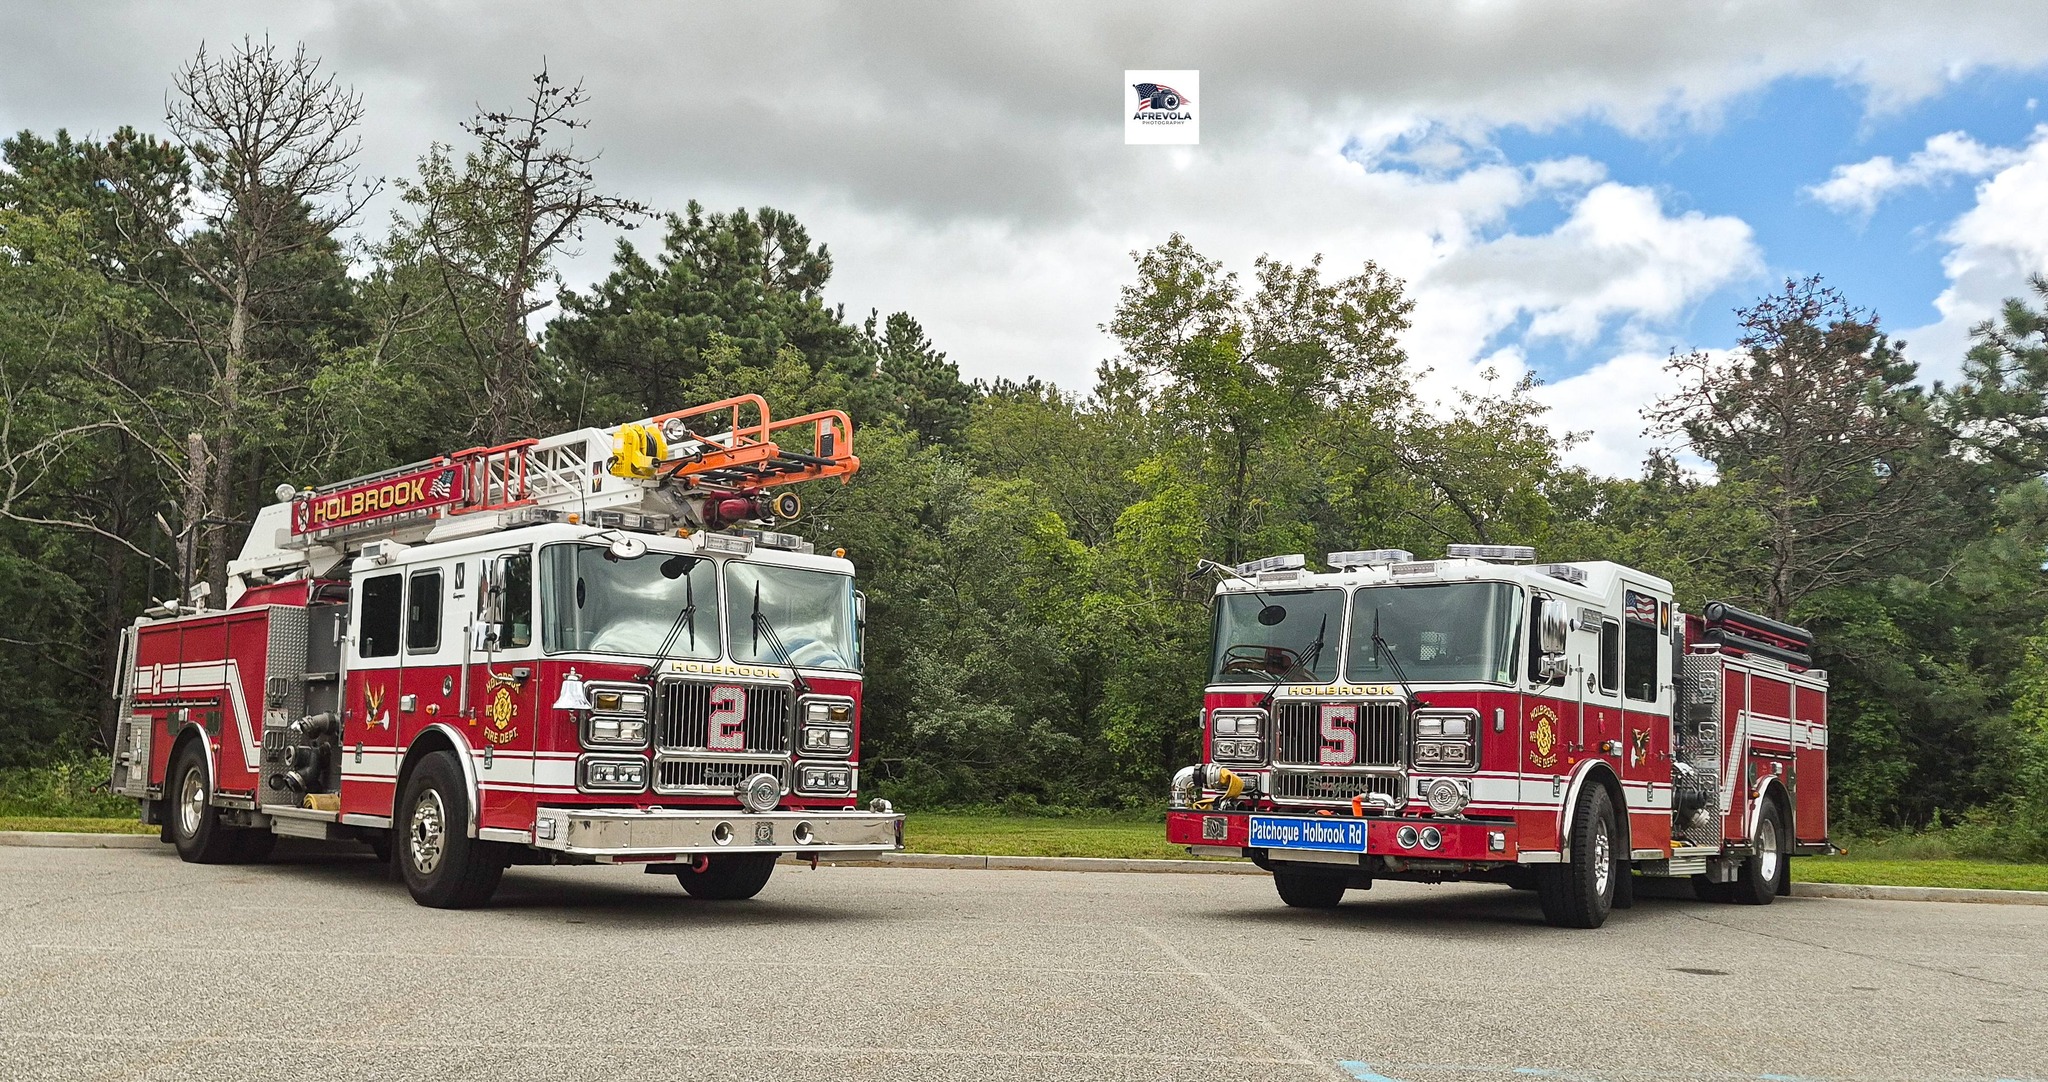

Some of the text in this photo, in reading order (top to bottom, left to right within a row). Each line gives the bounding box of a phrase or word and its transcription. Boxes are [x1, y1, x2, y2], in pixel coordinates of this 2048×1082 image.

[314, 477, 426, 523] HOLBROOK
[152, 662, 161, 696] 2
[671, 662, 781, 678] HOLBROOK
[1288, 686, 1394, 695] HOLBROOK
[512, 704, 518, 716] 2
[708, 684, 747, 752] 2
[1529, 704, 1558, 726] HOLBROOK
[484, 726, 519, 744] FIRE DEPT.
[1320, 704, 1357, 766] 5
[1552, 733, 1556, 745] 5
[1529, 750, 1542, 767] FIRE
[1252, 819, 1362, 845] Patchogue Holbrook Rd
